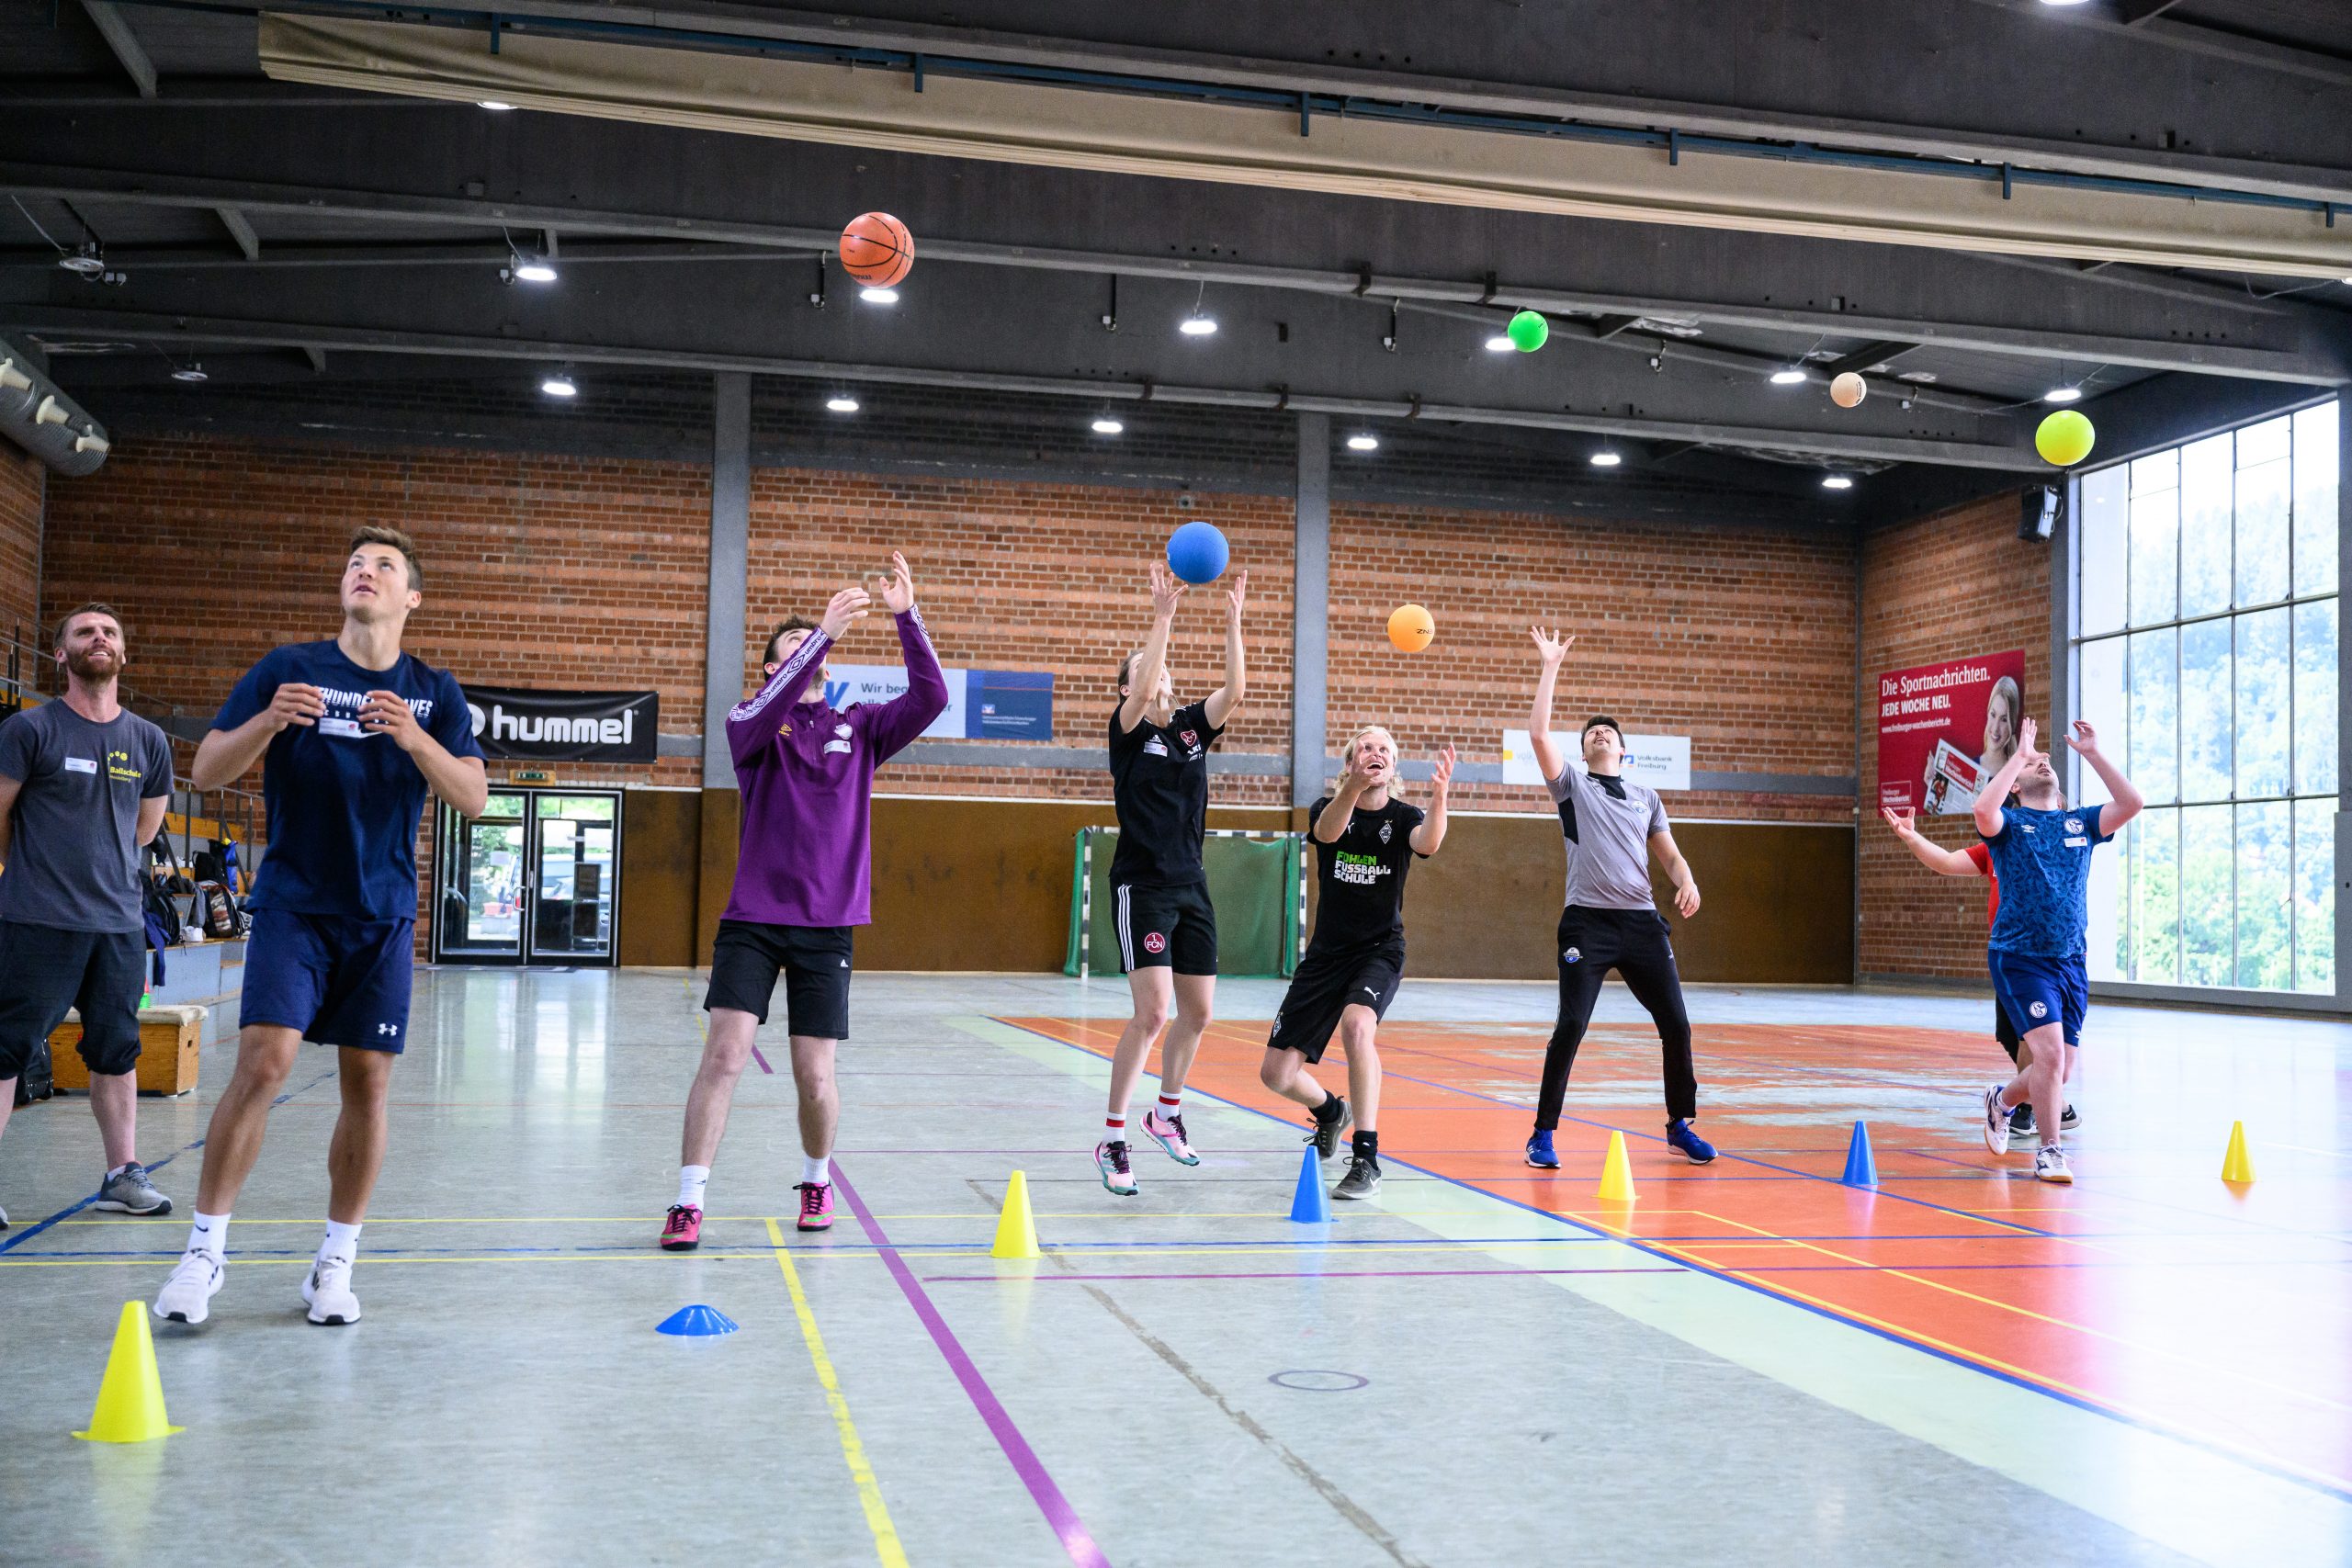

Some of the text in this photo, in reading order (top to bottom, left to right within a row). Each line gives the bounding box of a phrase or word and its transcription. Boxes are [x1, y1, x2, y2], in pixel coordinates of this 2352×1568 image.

[804, 636, 821, 655] umbro
[770, 673, 788, 693] umbro
[861, 682, 882, 694] Wir
[1882, 665, 1991, 697] Die Sportnachrichten.
[1882, 694, 1951, 717] JEDE WOCHE NEU.
[492, 705, 633, 744] hummel
[1881, 717, 1951, 733] www.freiburger-wochenbericht.de
[1637, 754, 1672, 762] Volksbank
[109, 766, 141, 778] Ballschule
[1637, 762, 1667, 771] Freiburg
[1336, 851, 1377, 866] FOHLEN
[1335, 860, 1391, 875] FUSSBALL
[1334, 869, 1376, 885] SCHULE
[1147, 941, 1163, 949] FCN
